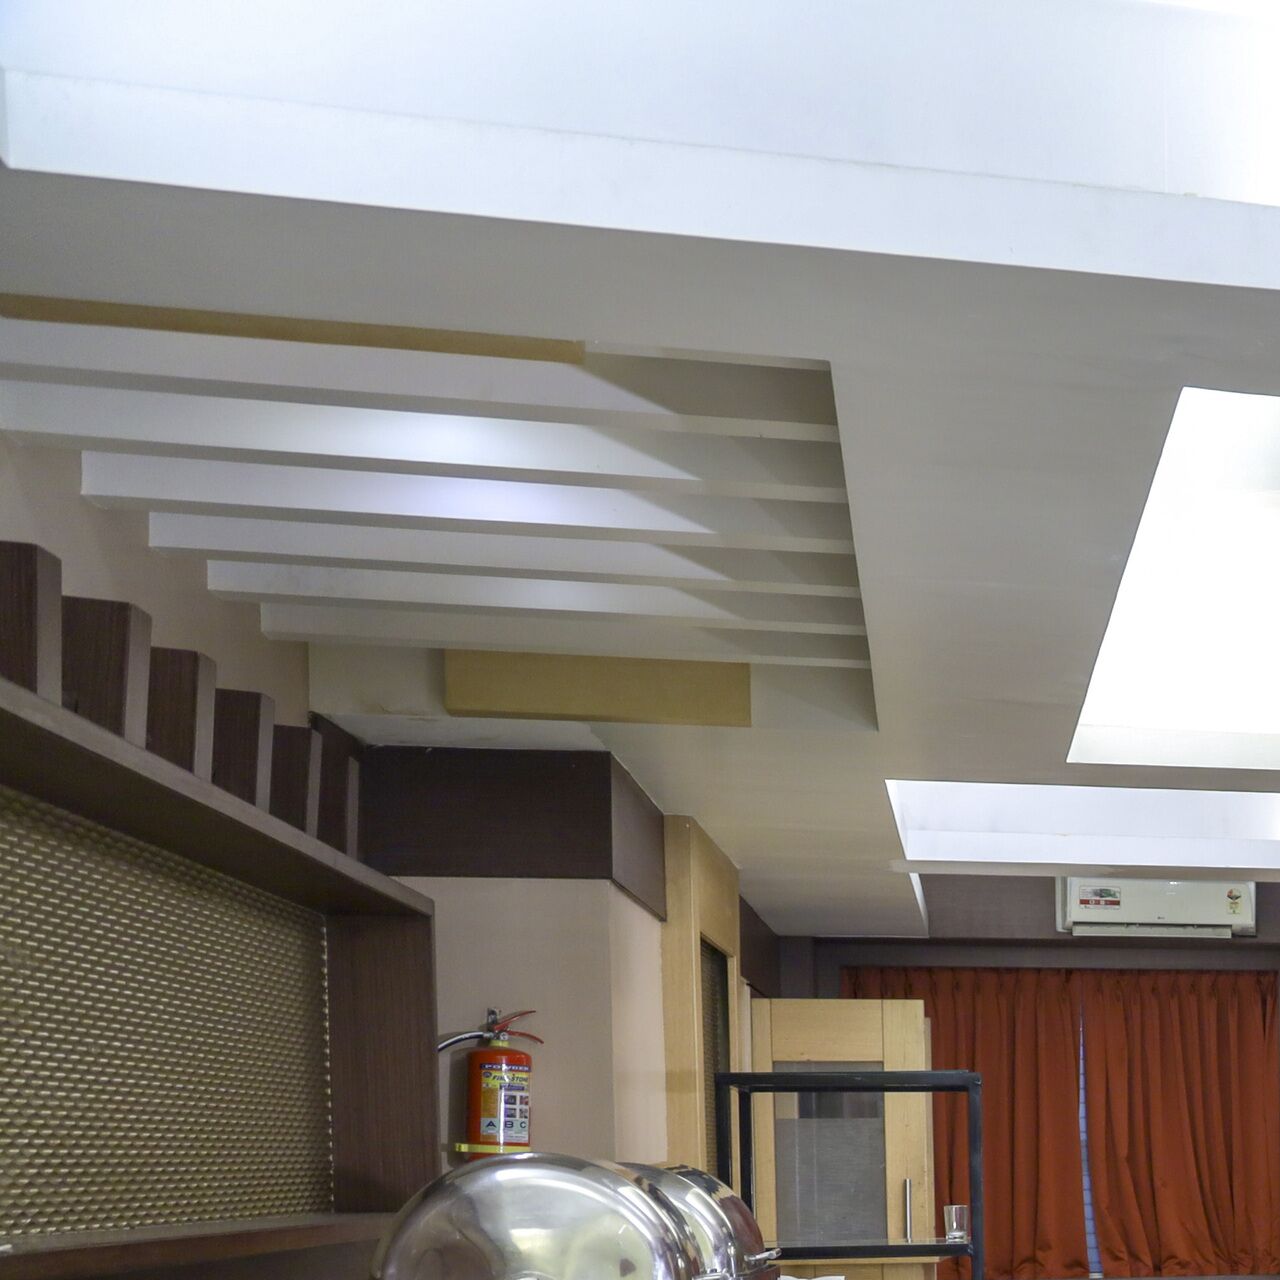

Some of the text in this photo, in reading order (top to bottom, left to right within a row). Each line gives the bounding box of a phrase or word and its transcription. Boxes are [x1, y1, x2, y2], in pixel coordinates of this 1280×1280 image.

[486, 1120, 527, 1129] A B C
